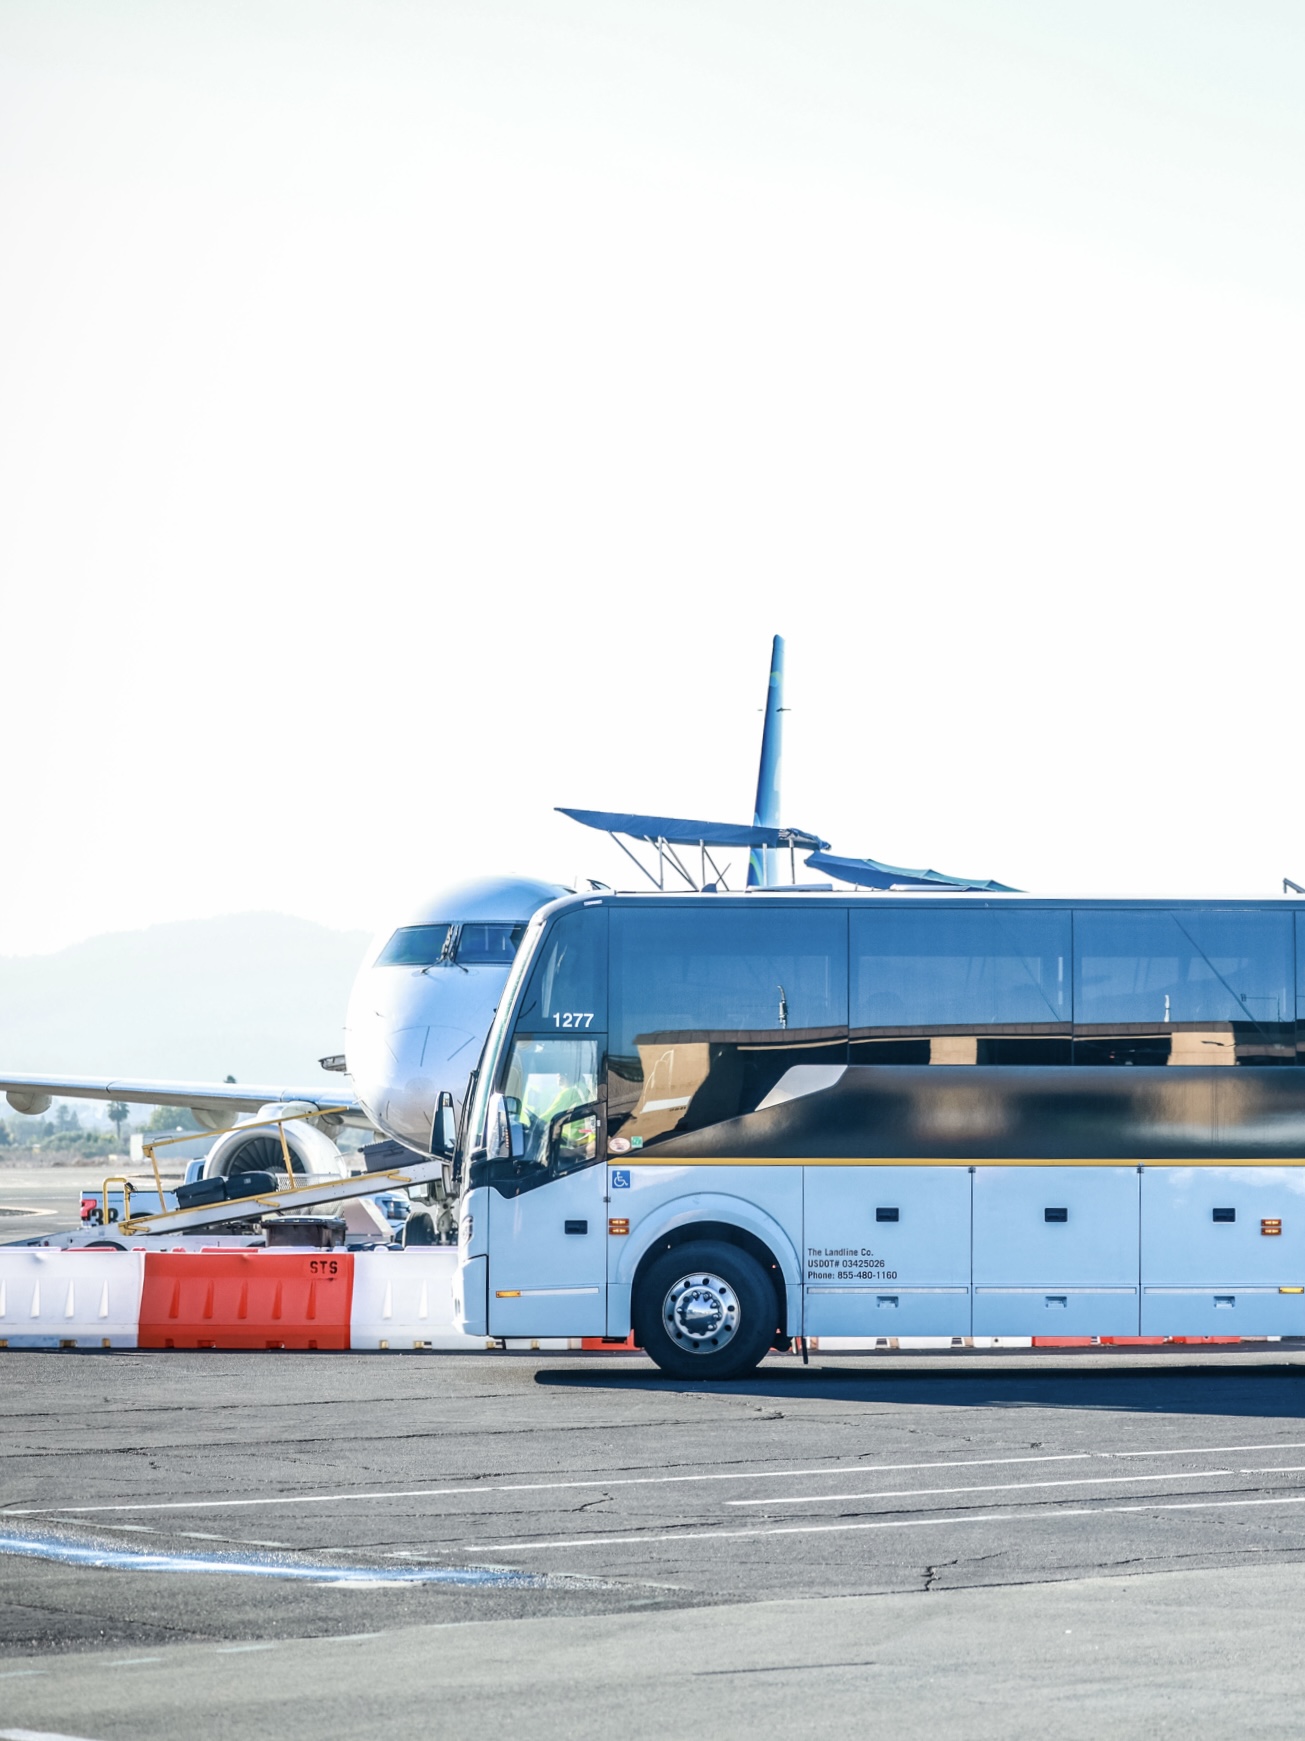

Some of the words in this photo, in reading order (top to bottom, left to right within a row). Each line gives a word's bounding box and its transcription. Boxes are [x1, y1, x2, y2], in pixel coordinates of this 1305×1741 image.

[552, 1012, 595, 1028] 1277
[807, 1248, 822, 1257] The
[824, 1248, 859, 1257] Landline
[860, 1248, 874, 1257] Co.
[310, 1260, 338, 1274] STS
[807, 1259, 840, 1268] USDOT#
[842, 1259, 885, 1268] 03425026
[807, 1271, 835, 1280] Phone:
[837, 1271, 898, 1280] 855-480-1160
